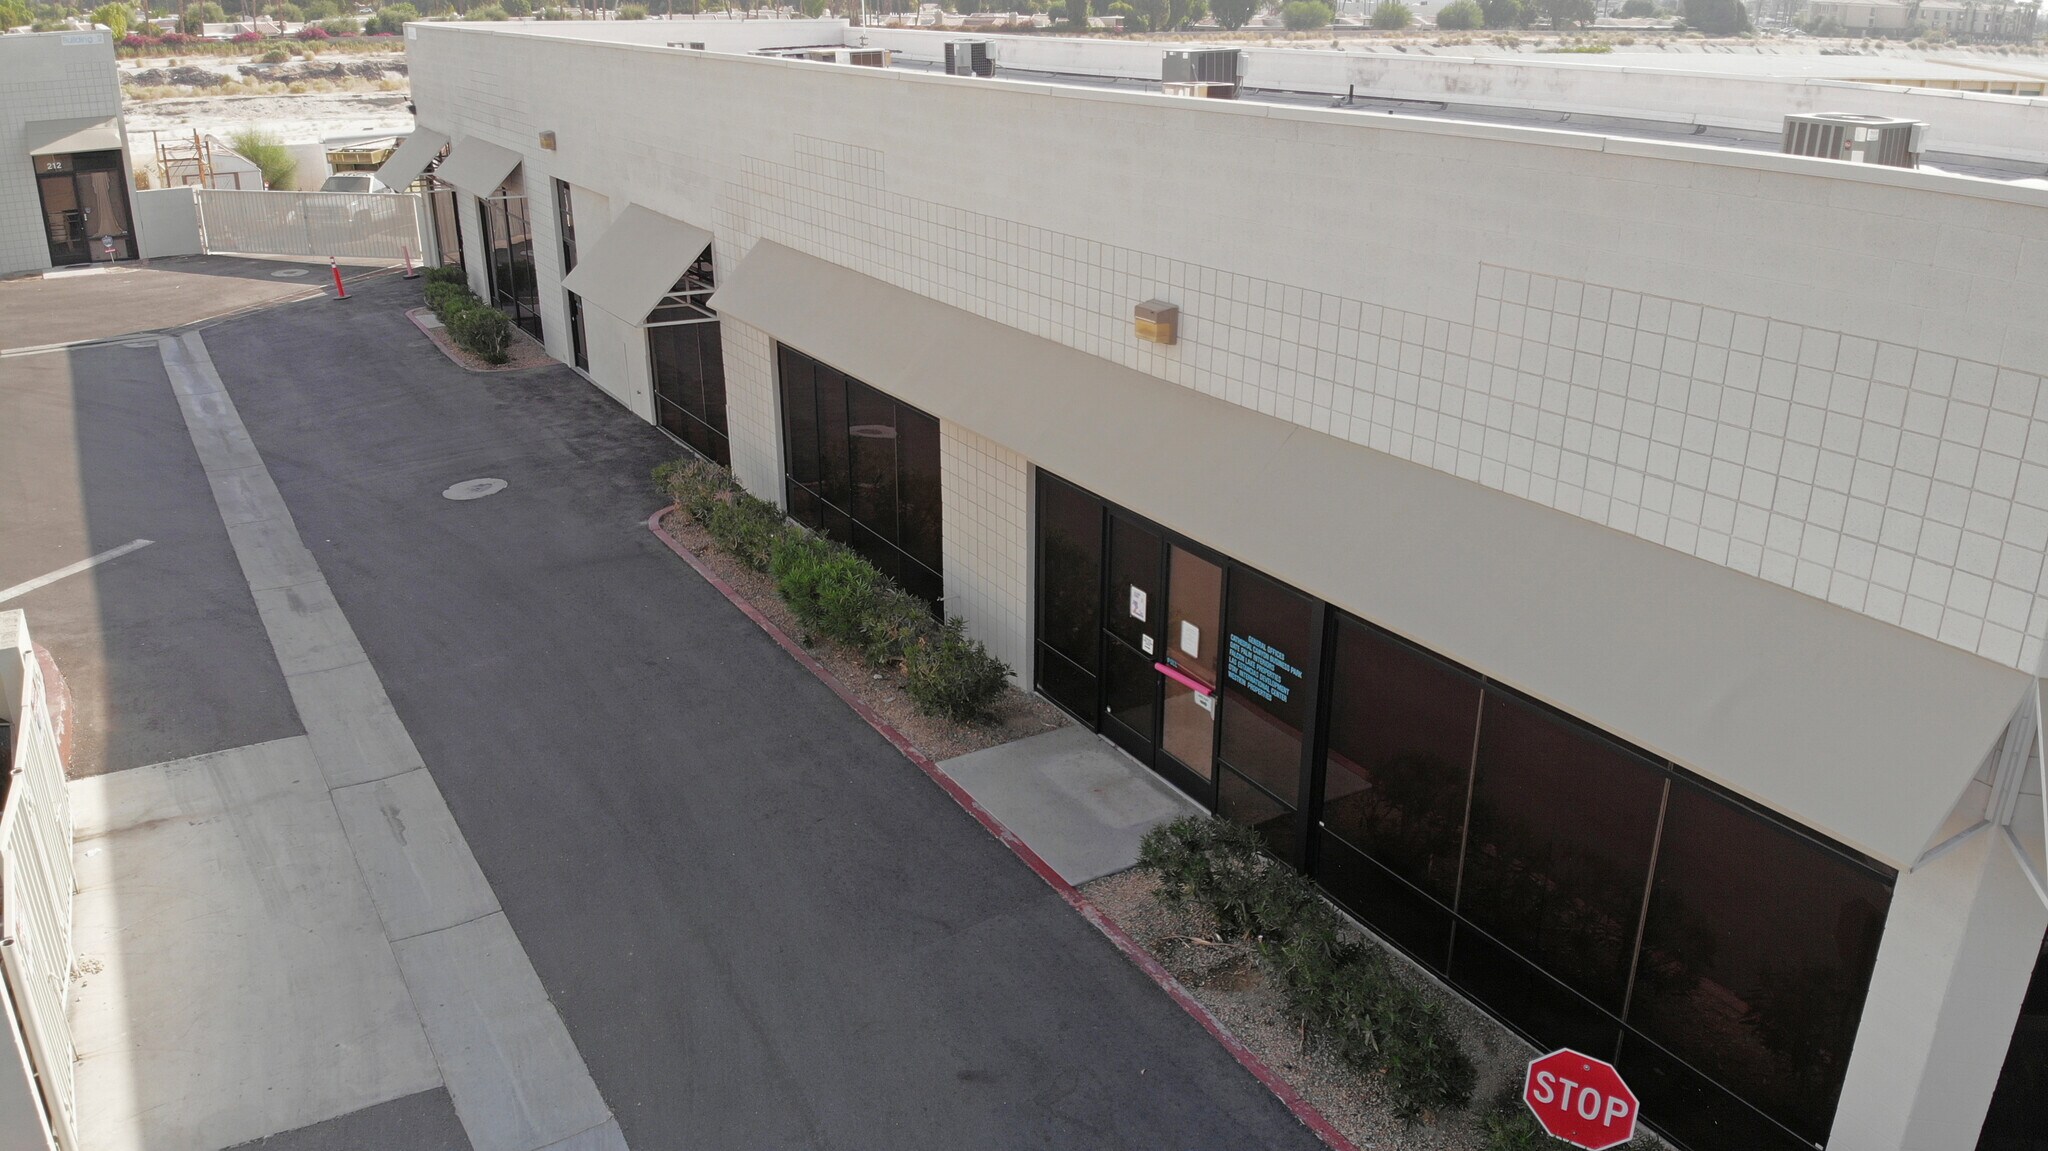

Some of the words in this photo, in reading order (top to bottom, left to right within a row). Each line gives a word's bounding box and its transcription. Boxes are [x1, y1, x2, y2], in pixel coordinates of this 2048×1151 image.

[47, 162, 62, 170] 212
[1230, 641, 1240, 652] DATE
[1240, 647, 1253, 659] PALM
[1230, 633, 1252, 651] CATHEDRAL
[1252, 646, 1270, 660] CANYON
[1269, 655, 1290, 672] BUSINESS
[1290, 666, 1302, 678] PARK
[1248, 635, 1266, 651] GENERAL
[1267, 645, 1285, 660] OFFICES
[1229, 656, 1237, 666] LAS
[1259, 673, 1290, 695] DEVELOPMENT
[1256, 663, 1281, 683] PROPERTIES
[1239, 670, 1270, 693] INTERNATIONAL
[1270, 687, 1288, 703] CENTER
[1247, 682, 1272, 701] PROPERTIES
[1533, 1071, 1629, 1127] STOP
